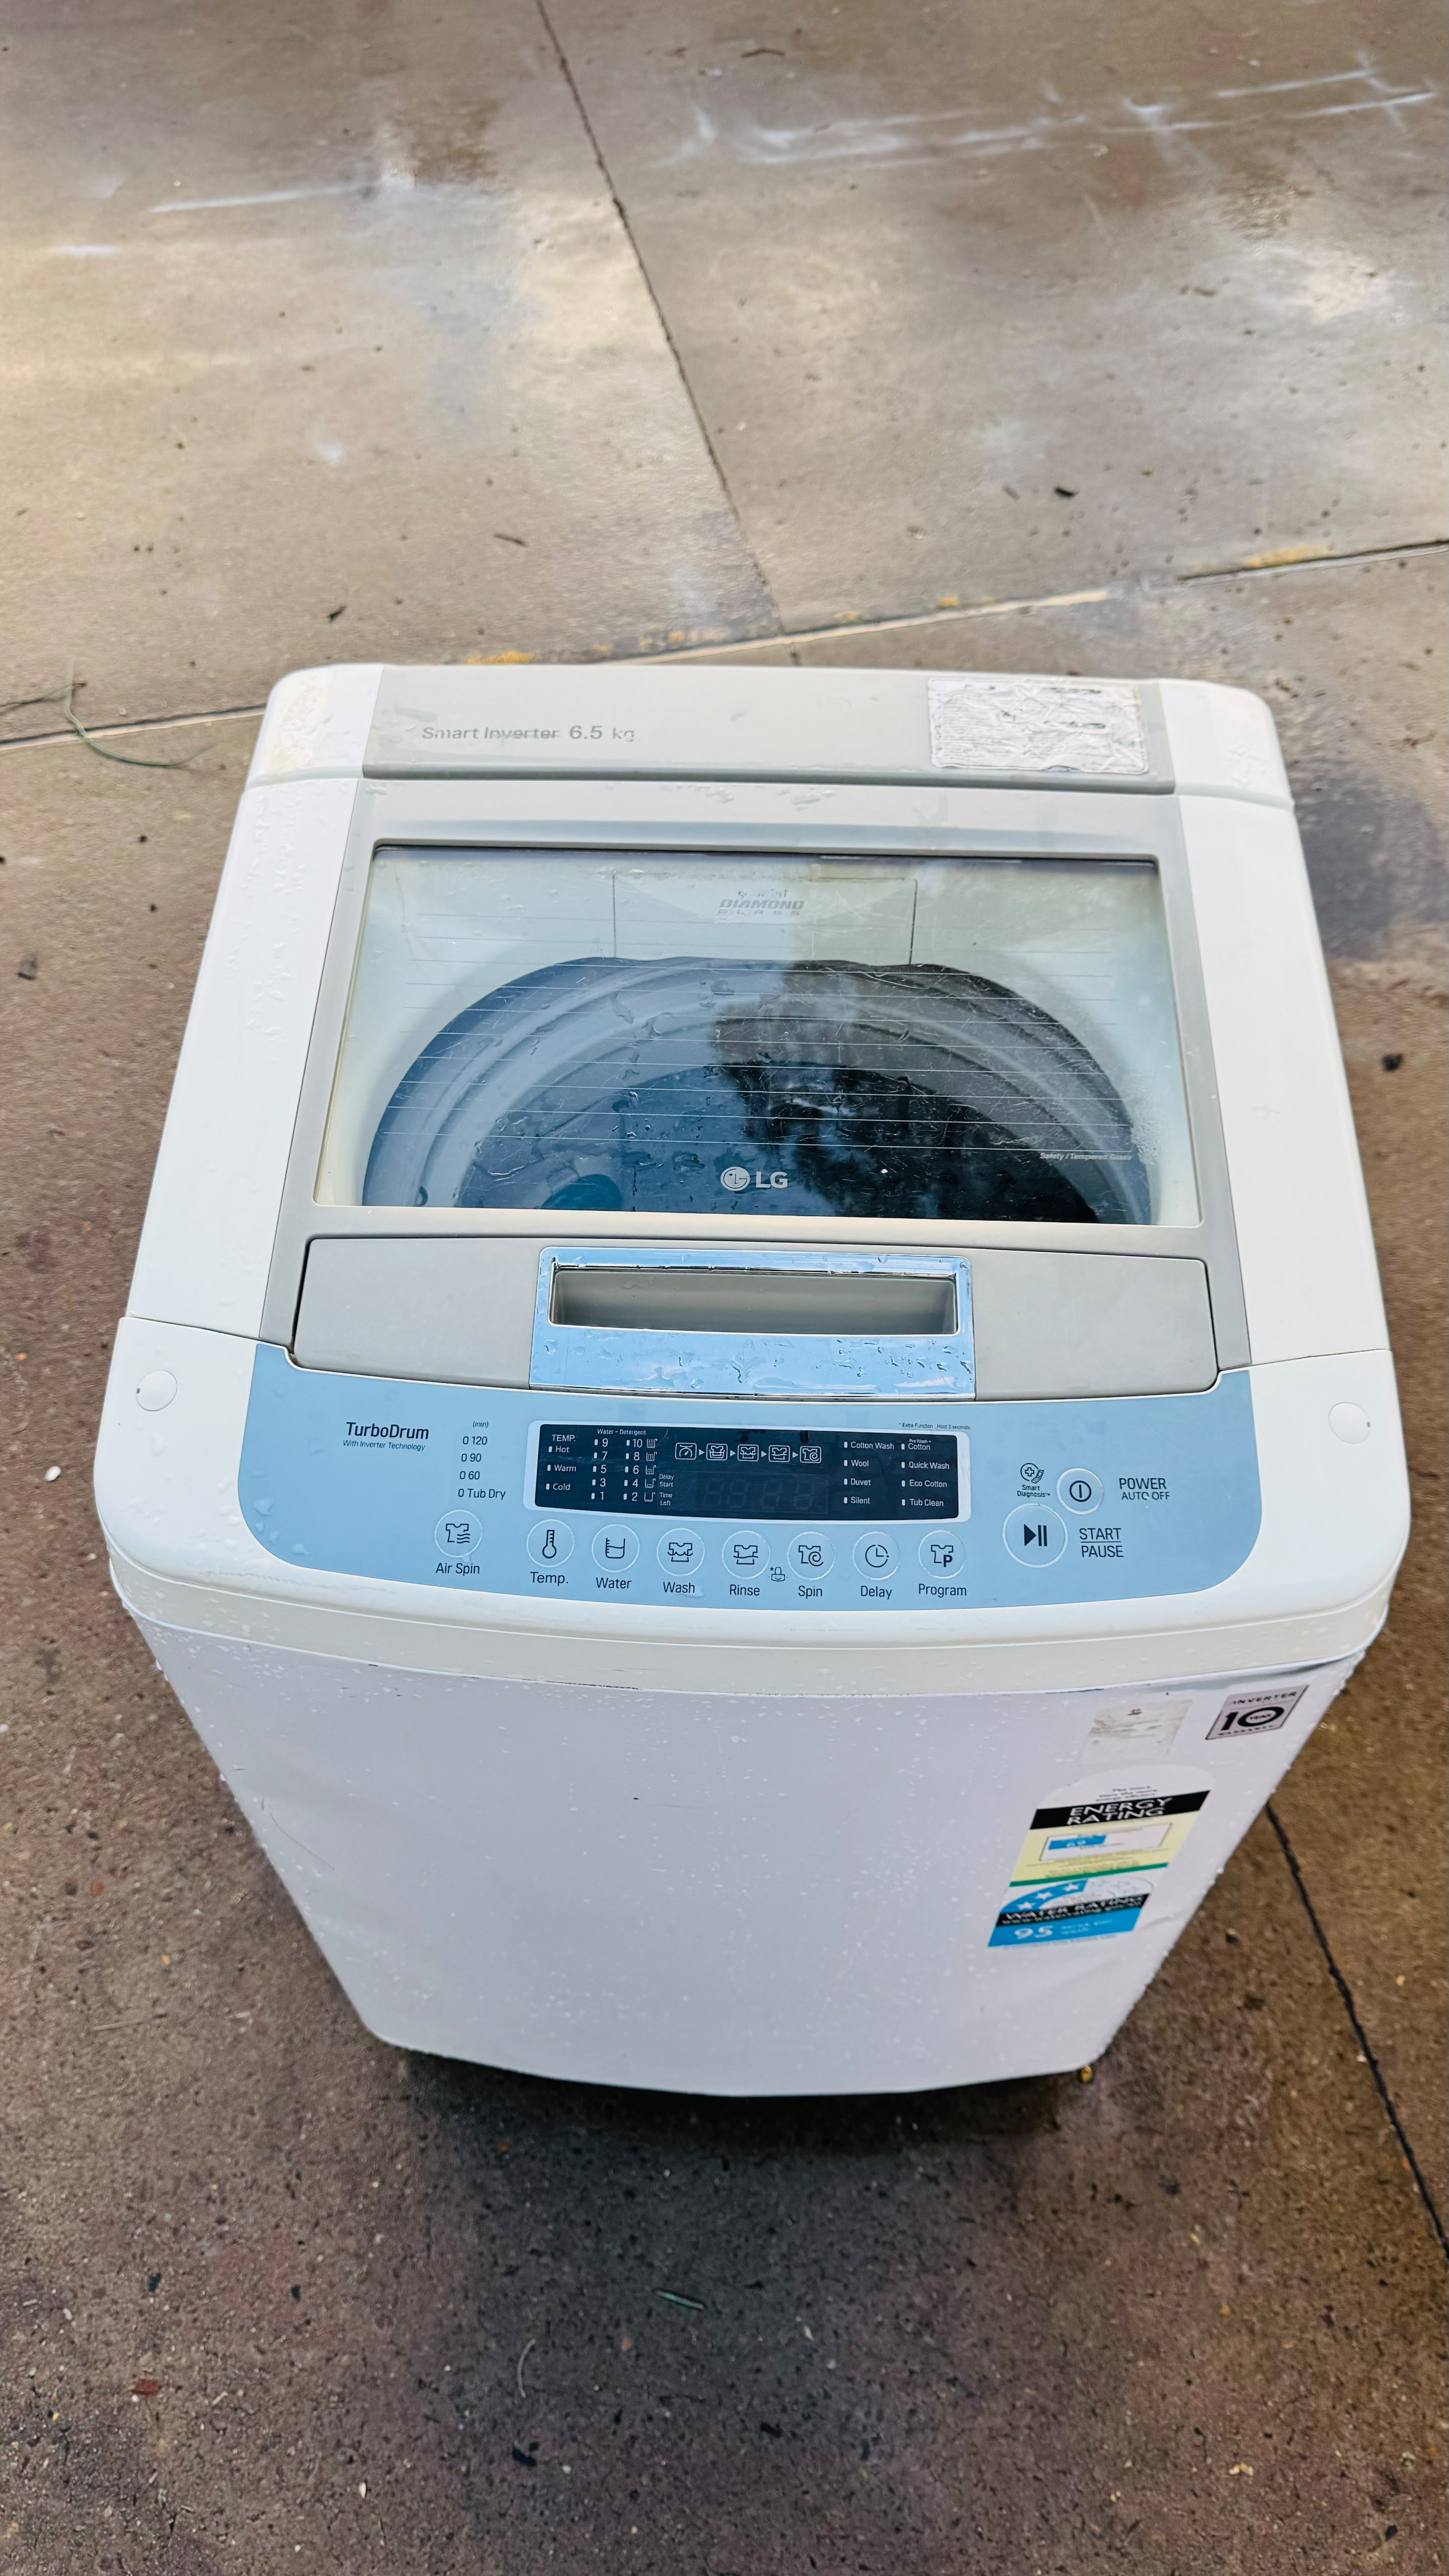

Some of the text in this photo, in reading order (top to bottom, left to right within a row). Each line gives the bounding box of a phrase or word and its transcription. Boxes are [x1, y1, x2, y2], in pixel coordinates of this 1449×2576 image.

[421, 725, 635, 742] Smart Inverter 6.5 kg
[719, 899, 805, 910] DIAMOND
[755, 1171, 788, 1189] LG
[472, 1420, 489, 1428] (min)
[346, 1421, 430, 1439] TurboDrum
[471, 1436, 488, 1445] 120
[551, 1434, 576, 1442] TEMP.
[602, 1438, 608, 1447] 9
[632, 1438, 643, 1448] 10
[360, 1440, 386, 1448] Inverter
[388, 1442, 426, 1452] Technology
[850, 1441, 895, 1450] Cotton Wash
[908, 1442, 931, 1451] Cotton
[469, 1453, 482, 1462] 90
[601, 1451, 608, 1461] 7
[633, 1452, 640, 1461] 8
[851, 1459, 869, 1468] Wool
[909, 1461, 950, 1470] Quick Wash
[601, 1465, 607, 1474] 5
[633, 1465, 639, 1474] 6
[468, 1471, 480, 1480] 60
[552, 1483, 571, 1491] Cold
[600, 1478, 606, 1487] 3
[632, 1479, 638, 1488] 4
[850, 1478, 871, 1486] Duvet
[924, 1480, 947, 1488] Cotton
[1118, 1478, 1167, 1490] POWER
[467, 1488, 506, 1500] Tub Dry
[600, 1491, 604, 1500] 1
[631, 1492, 638, 1501] 2
[1121, 1491, 1170, 1500] AUTO OFF
[850, 1496, 870, 1505] Silent
[910, 1498, 944, 1507] Tub Clean
[1079, 1527, 1121, 1540] START
[1081, 1545, 1124, 1558] PAUSE
[435, 1562, 480, 1577] Air Spin
[530, 1571, 569, 1587] Temp.
[596, 1577, 632, 1589] Water
[663, 1581, 695, 1594] Wash
[729, 1584, 760, 1596] Rinse
[798, 1585, 823, 1599] Spin
[860, 1585, 893, 1600] Delay
[918, 1583, 967, 1598] Program
[1233, 1691, 1297, 1705] INVERTER
[1220, 1706, 1285, 1731] 10
[1069, 1797, 1173, 1816] ENERGY
[1066, 1807, 1165, 1825] RATING
[1013, 1925, 1054, 1940] 95
